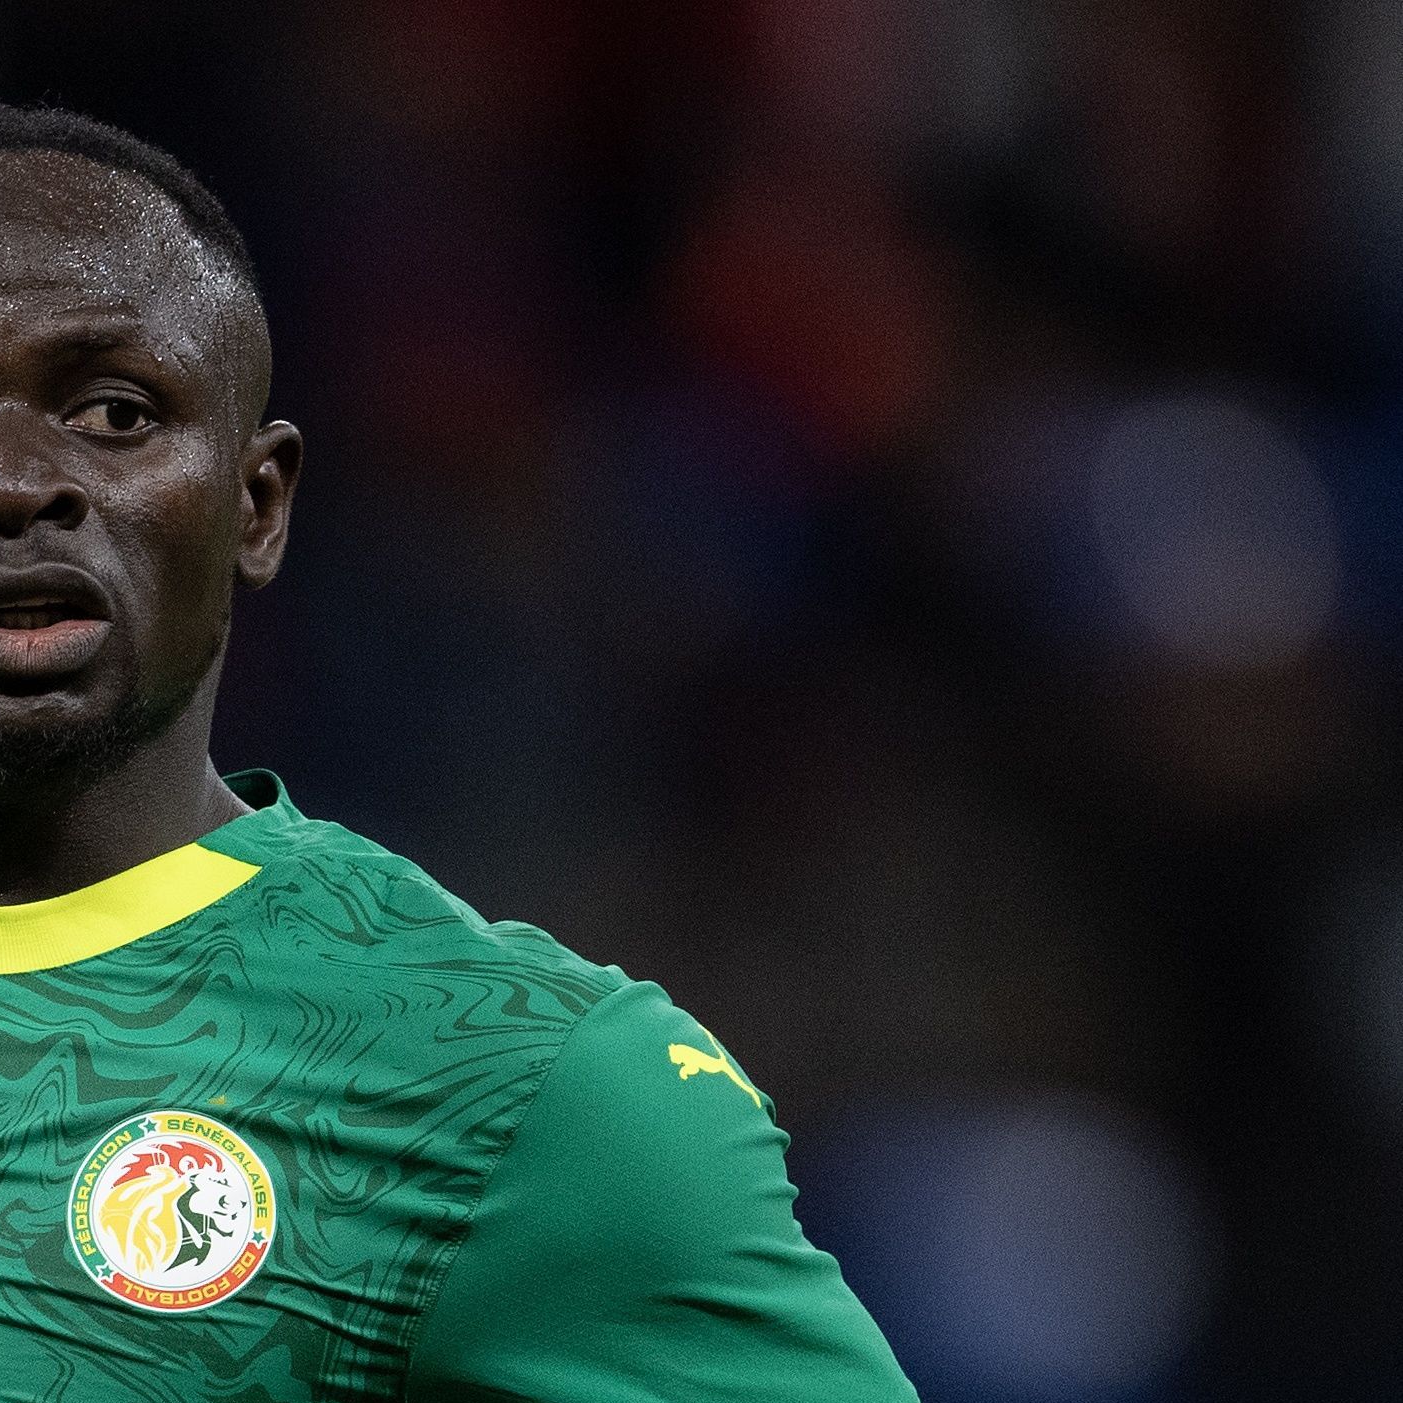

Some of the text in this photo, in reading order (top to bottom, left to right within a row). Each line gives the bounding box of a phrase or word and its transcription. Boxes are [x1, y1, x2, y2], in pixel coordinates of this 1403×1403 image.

[73, 1118, 268, 1305] FÉDÉRATION SÉNÉGALAISE DE FOOTBALL
